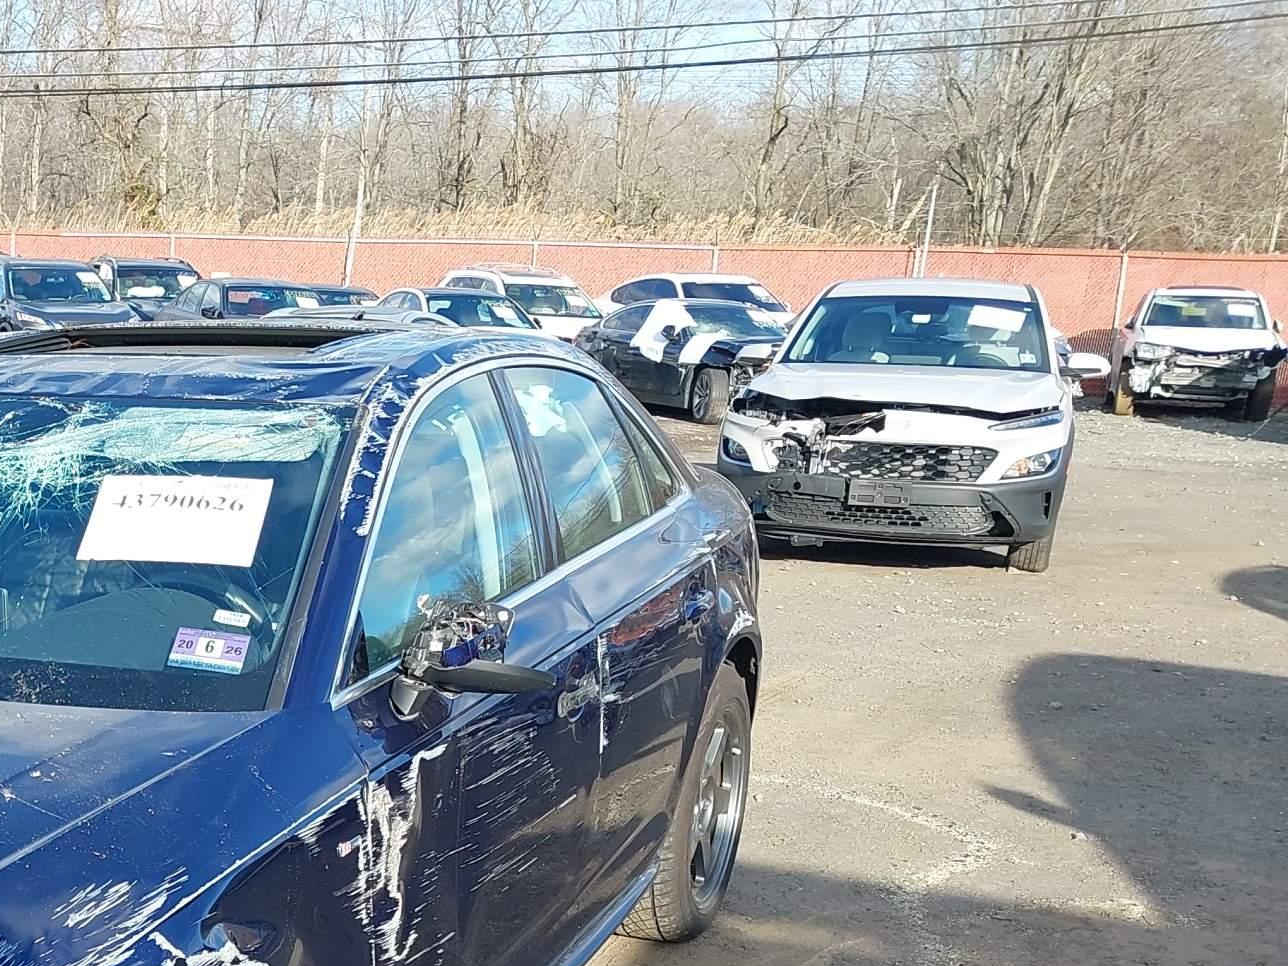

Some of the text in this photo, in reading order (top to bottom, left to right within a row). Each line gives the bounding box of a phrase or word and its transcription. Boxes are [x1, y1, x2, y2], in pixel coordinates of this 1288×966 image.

[112, 493, 245, 512] 43790626
[177, 639, 243, 656] 20 6 26
